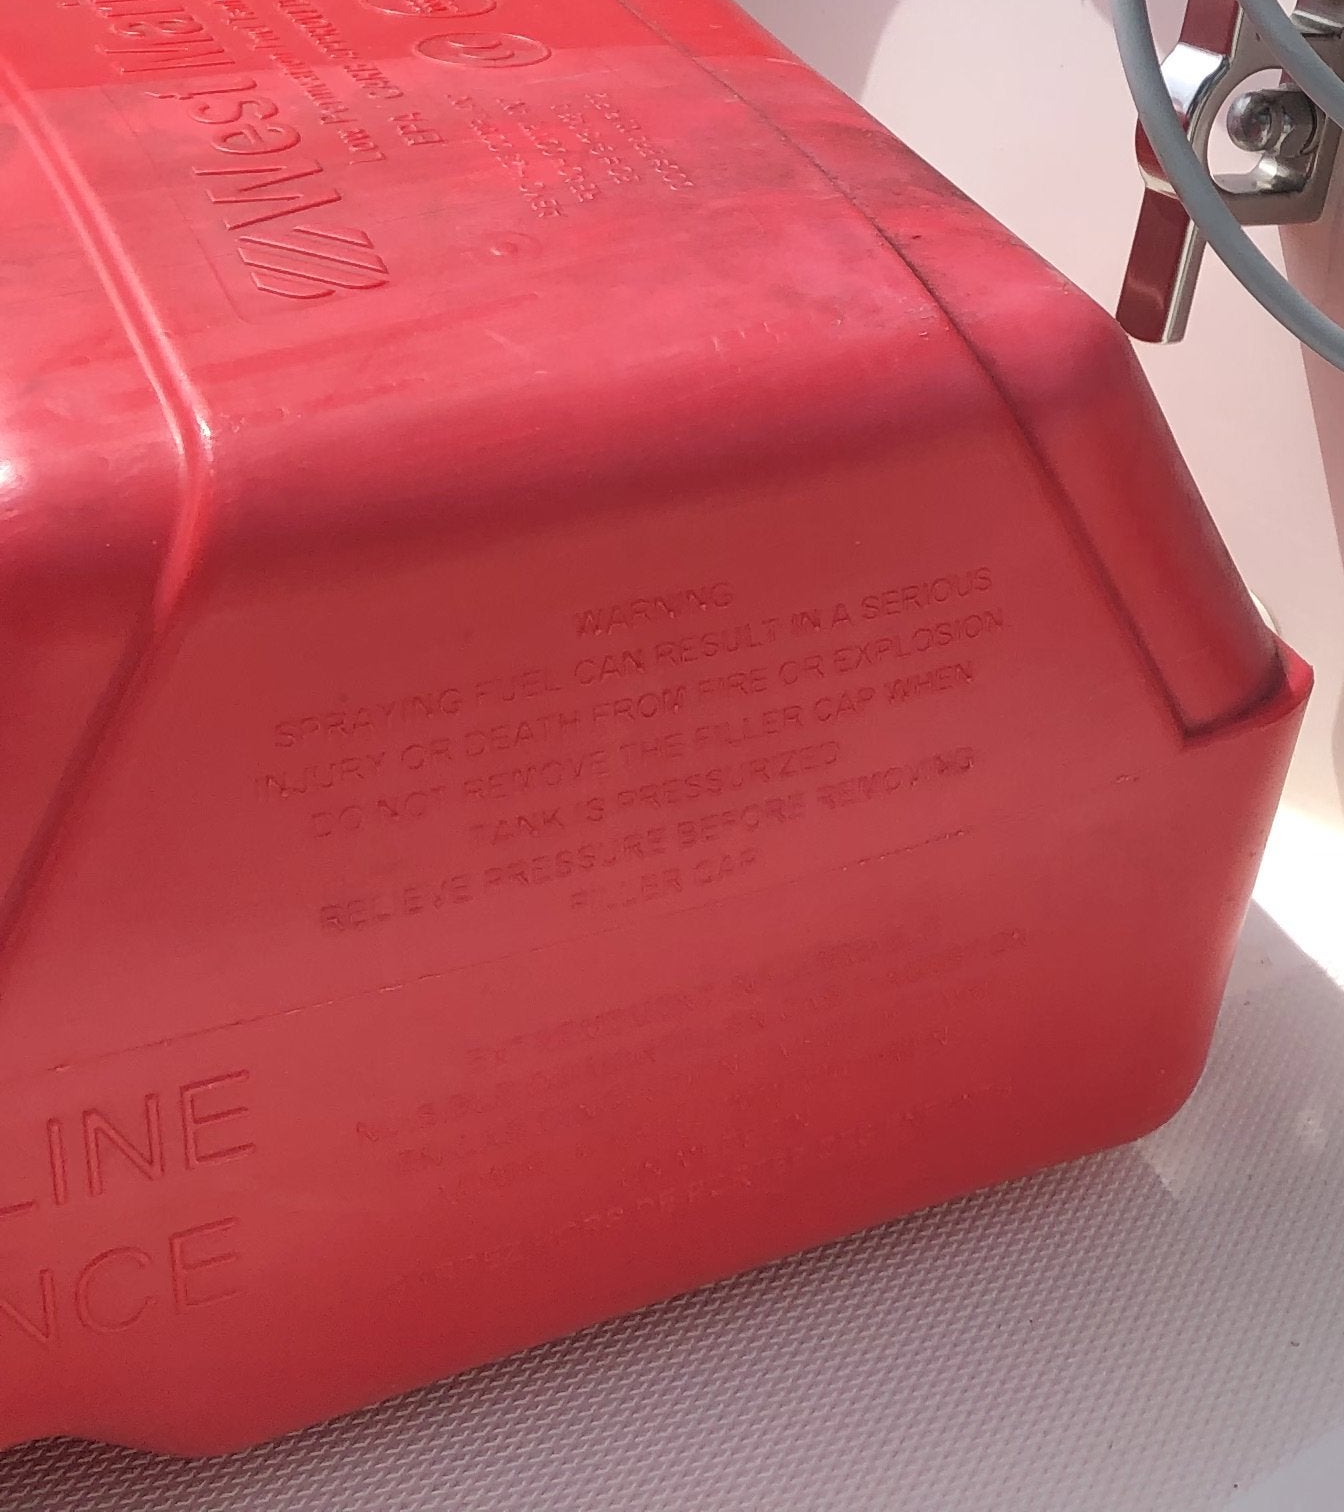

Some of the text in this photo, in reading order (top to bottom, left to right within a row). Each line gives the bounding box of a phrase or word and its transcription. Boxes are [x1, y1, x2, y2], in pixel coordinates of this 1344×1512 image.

[145, 79, 343, 232] West
[273, 685, 464, 750] SPRAYING
[473, 665, 563, 706] FUEL
[573, 649, 646, 686] CAN
[654, 617, 780, 667] RESULT
[831, 602, 850, 629] A
[860, 566, 993, 621] SERIOUS
[574, 581, 735, 637] WARNING
[255, 607, 1005, 803] INJURY OR DEATH FROM FIRE OR EXPLOSION
[310, 660, 974, 839] DO NOT REMOVE THE FILLER CAP WHEN
[319, 874, 475, 932] RELIEVE
[483, 827, 668, 886] PRESSURE
[677, 793, 805, 849] BEFORE
[469, 805, 566, 847] TANK
